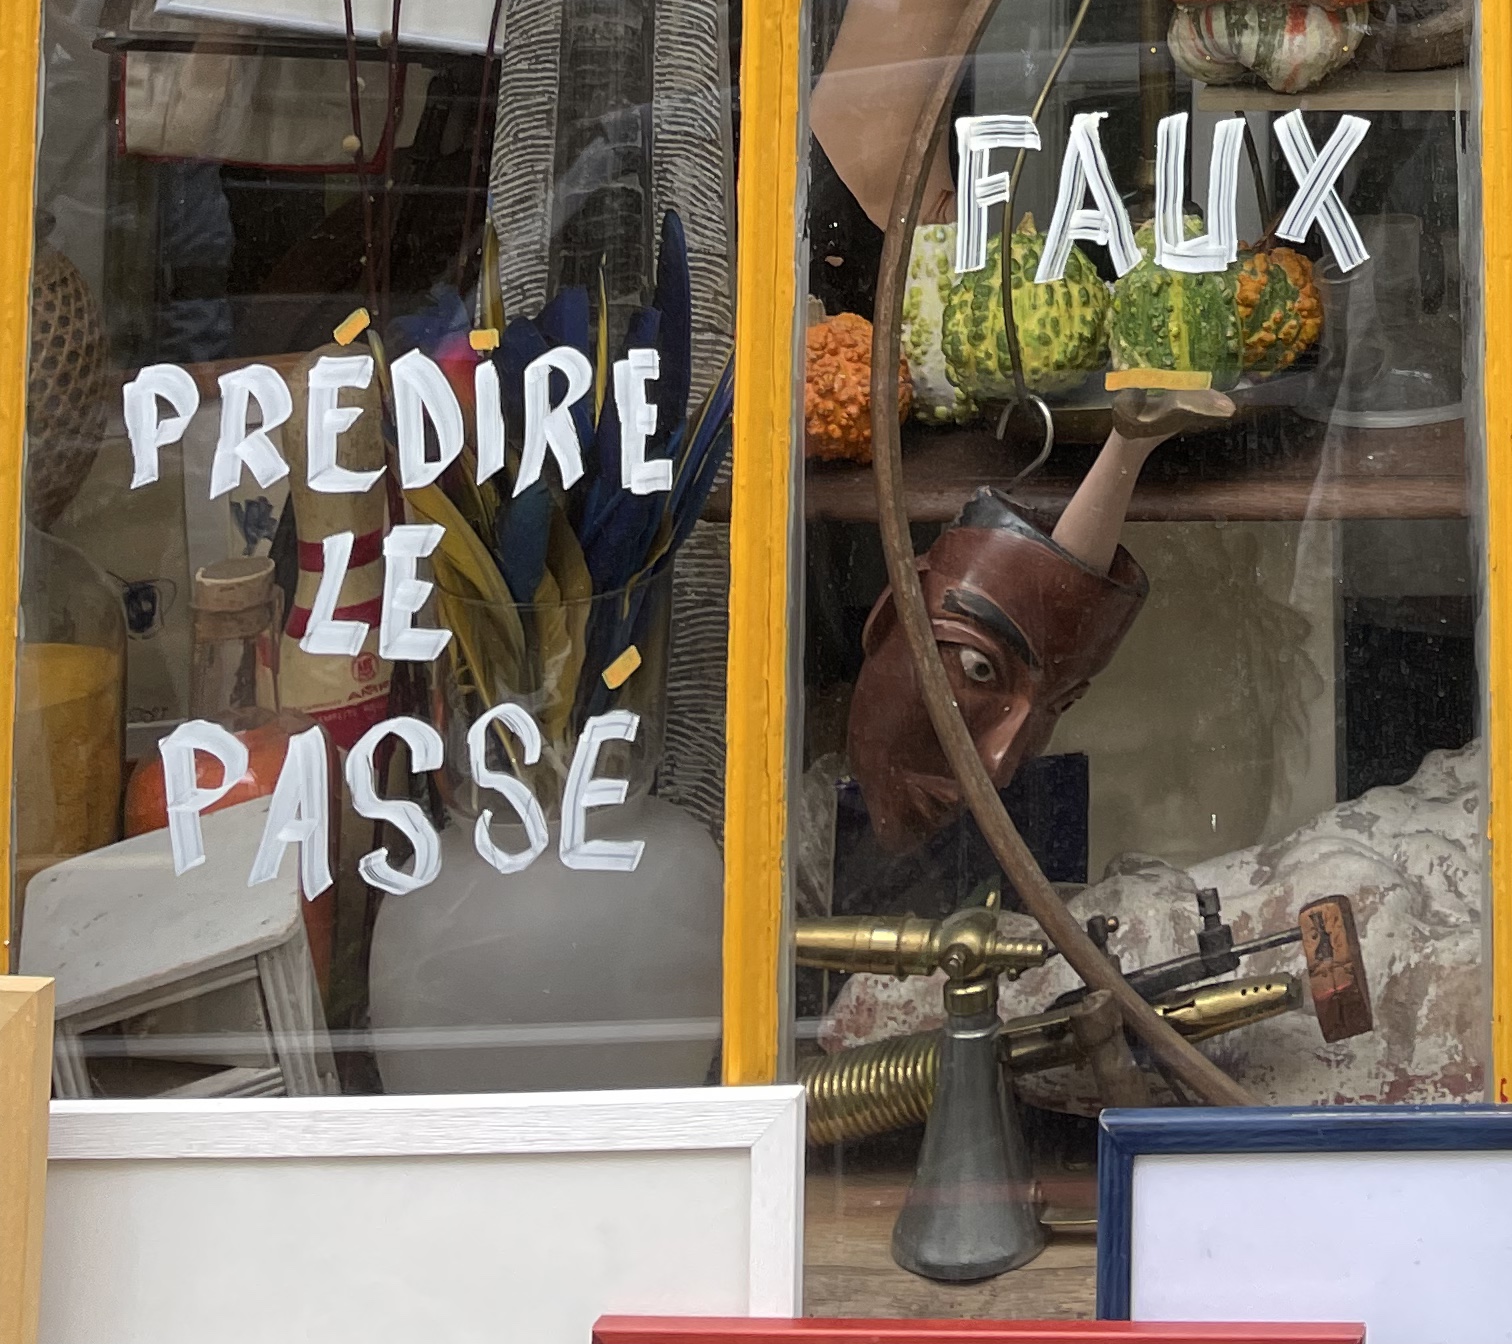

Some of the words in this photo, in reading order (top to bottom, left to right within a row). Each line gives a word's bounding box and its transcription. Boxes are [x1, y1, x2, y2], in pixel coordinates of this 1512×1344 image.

[954, 108, 1373, 283] FAUX
[122, 307, 674, 500] PRÉDIRE
[300, 523, 454, 661] LE
[157, 644, 646, 902] PASSÉ
